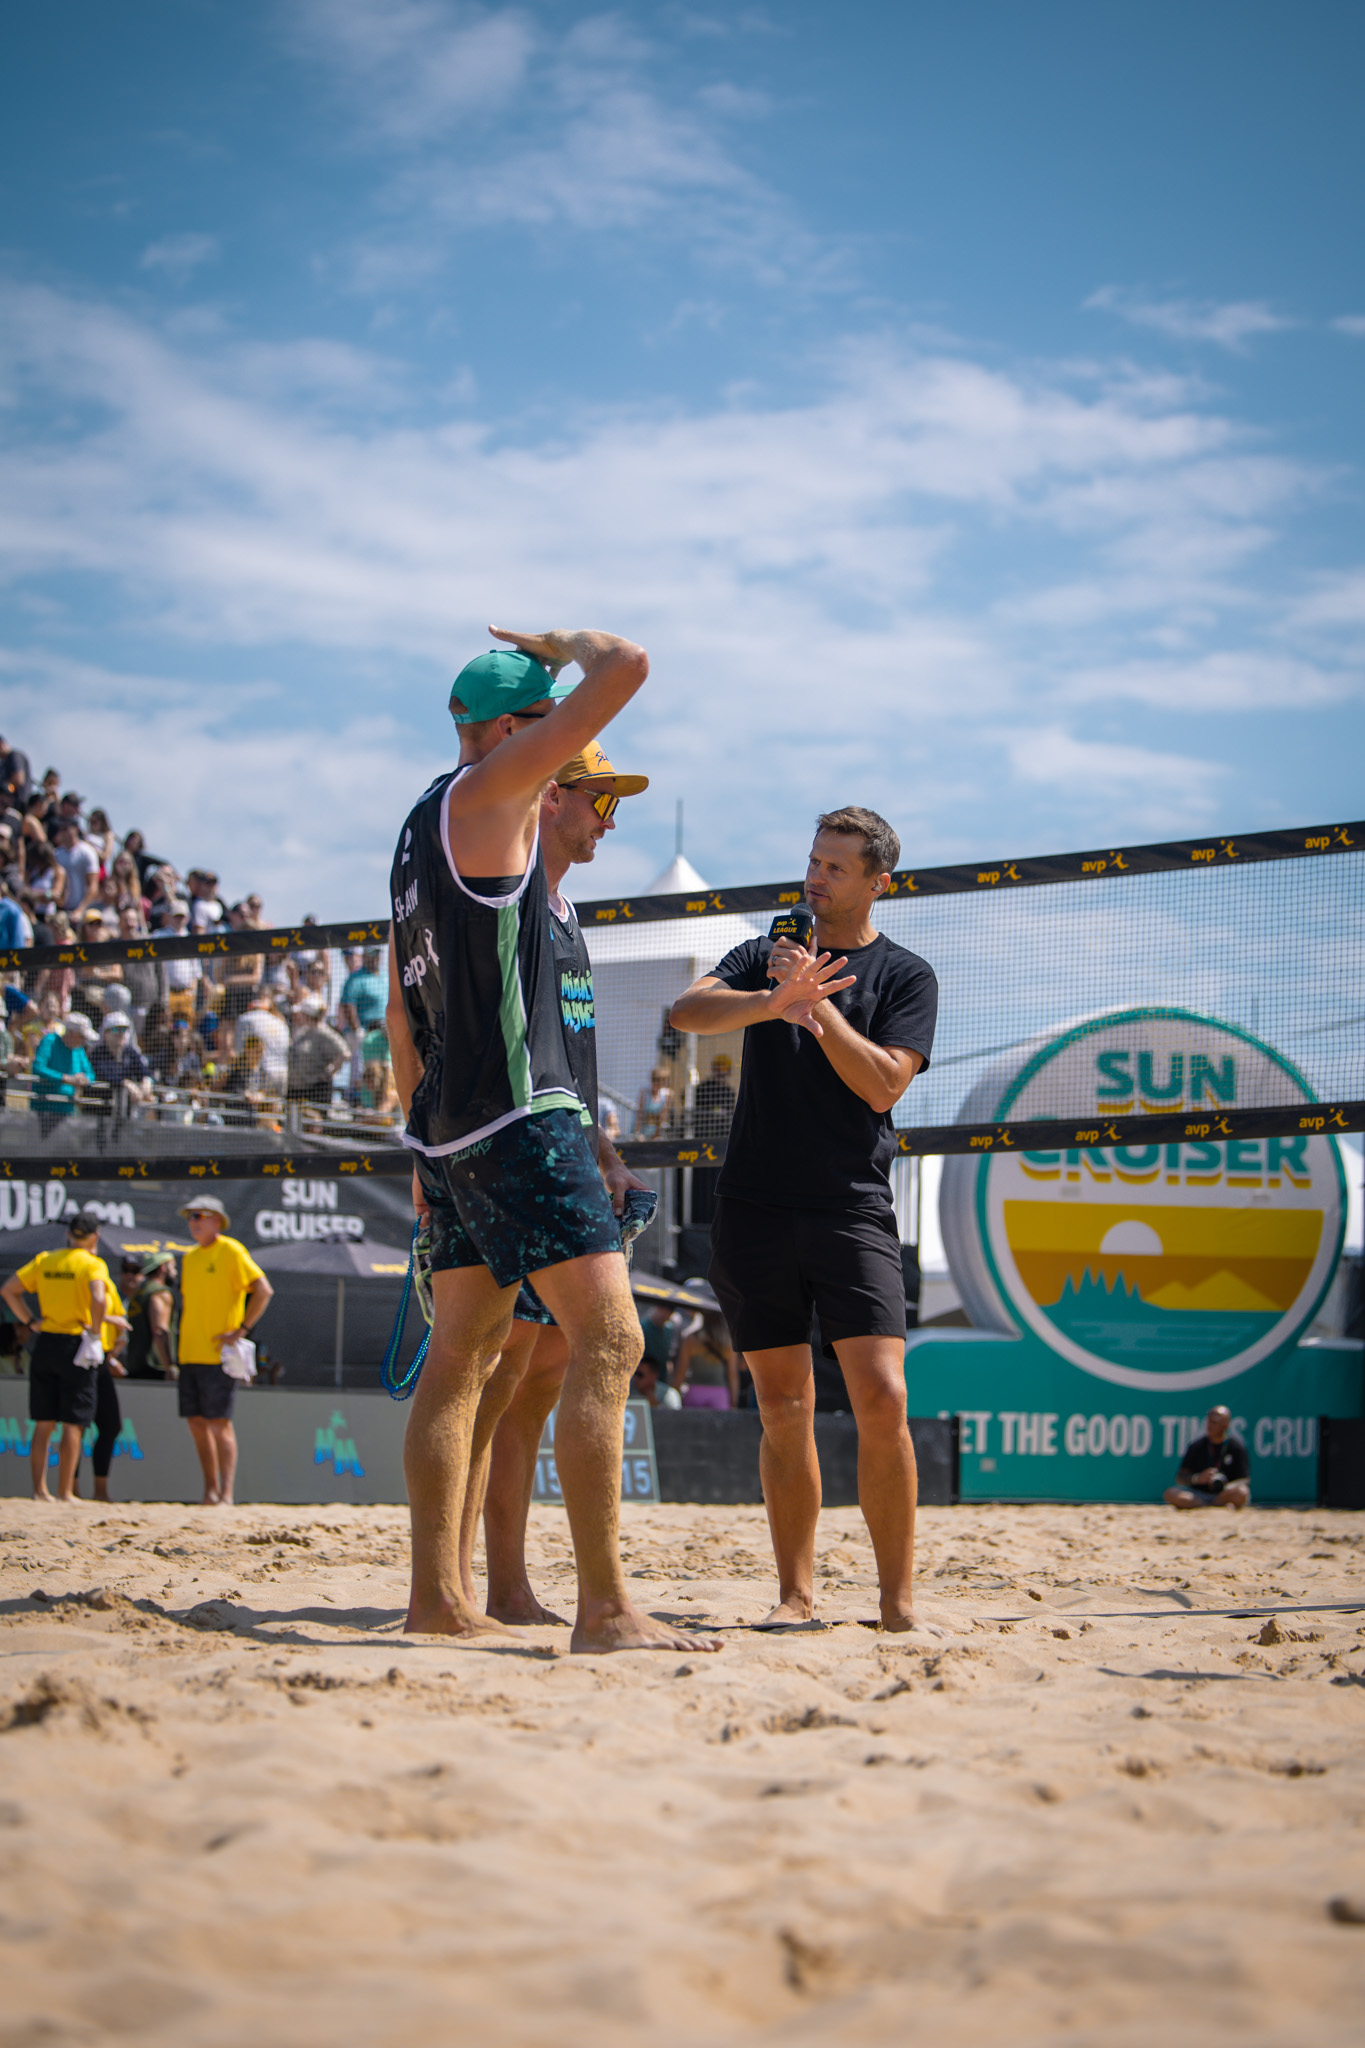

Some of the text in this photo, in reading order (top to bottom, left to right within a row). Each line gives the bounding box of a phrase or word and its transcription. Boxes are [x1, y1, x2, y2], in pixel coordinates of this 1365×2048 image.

[1305, 836, 1330, 850] avp
[1191, 848, 1216, 862] avp
[1082, 860, 1107, 873] avp
[977, 871, 1000, 885] avp
[779, 891, 800, 904] avp
[686, 900, 707, 913] avp
[596, 909, 617, 921] avp
[348, 930, 367, 942] avp
[773, 926, 798, 934] LEAGUE
[198, 942, 215, 954] avp
[271, 937, 289, 948] avp
[1096, 1051, 1236, 1109] SUN
[1299, 1116, 1325, 1131] avp
[1075, 1130, 1099, 1144] avp
[1185, 1124, 1210, 1138] avp
[970, 1136, 993, 1149] avp
[678, 1151, 699, 1163] avp
[118, 1166, 135, 1178] avp
[189, 1165, 206, 1177] avp
[262, 1164, 280, 1176] avp
[339, 1161, 358, 1174] avp
[281, 1178, 338, 1209] SUN
[255, 1209, 365, 1240] CRUISER
[938, 1410, 993, 1454] ET
[998, 1412, 1060, 1456] THE
[1064, 1413, 1153, 1457] GOOD
[622, 1459, 652, 1495] 15
